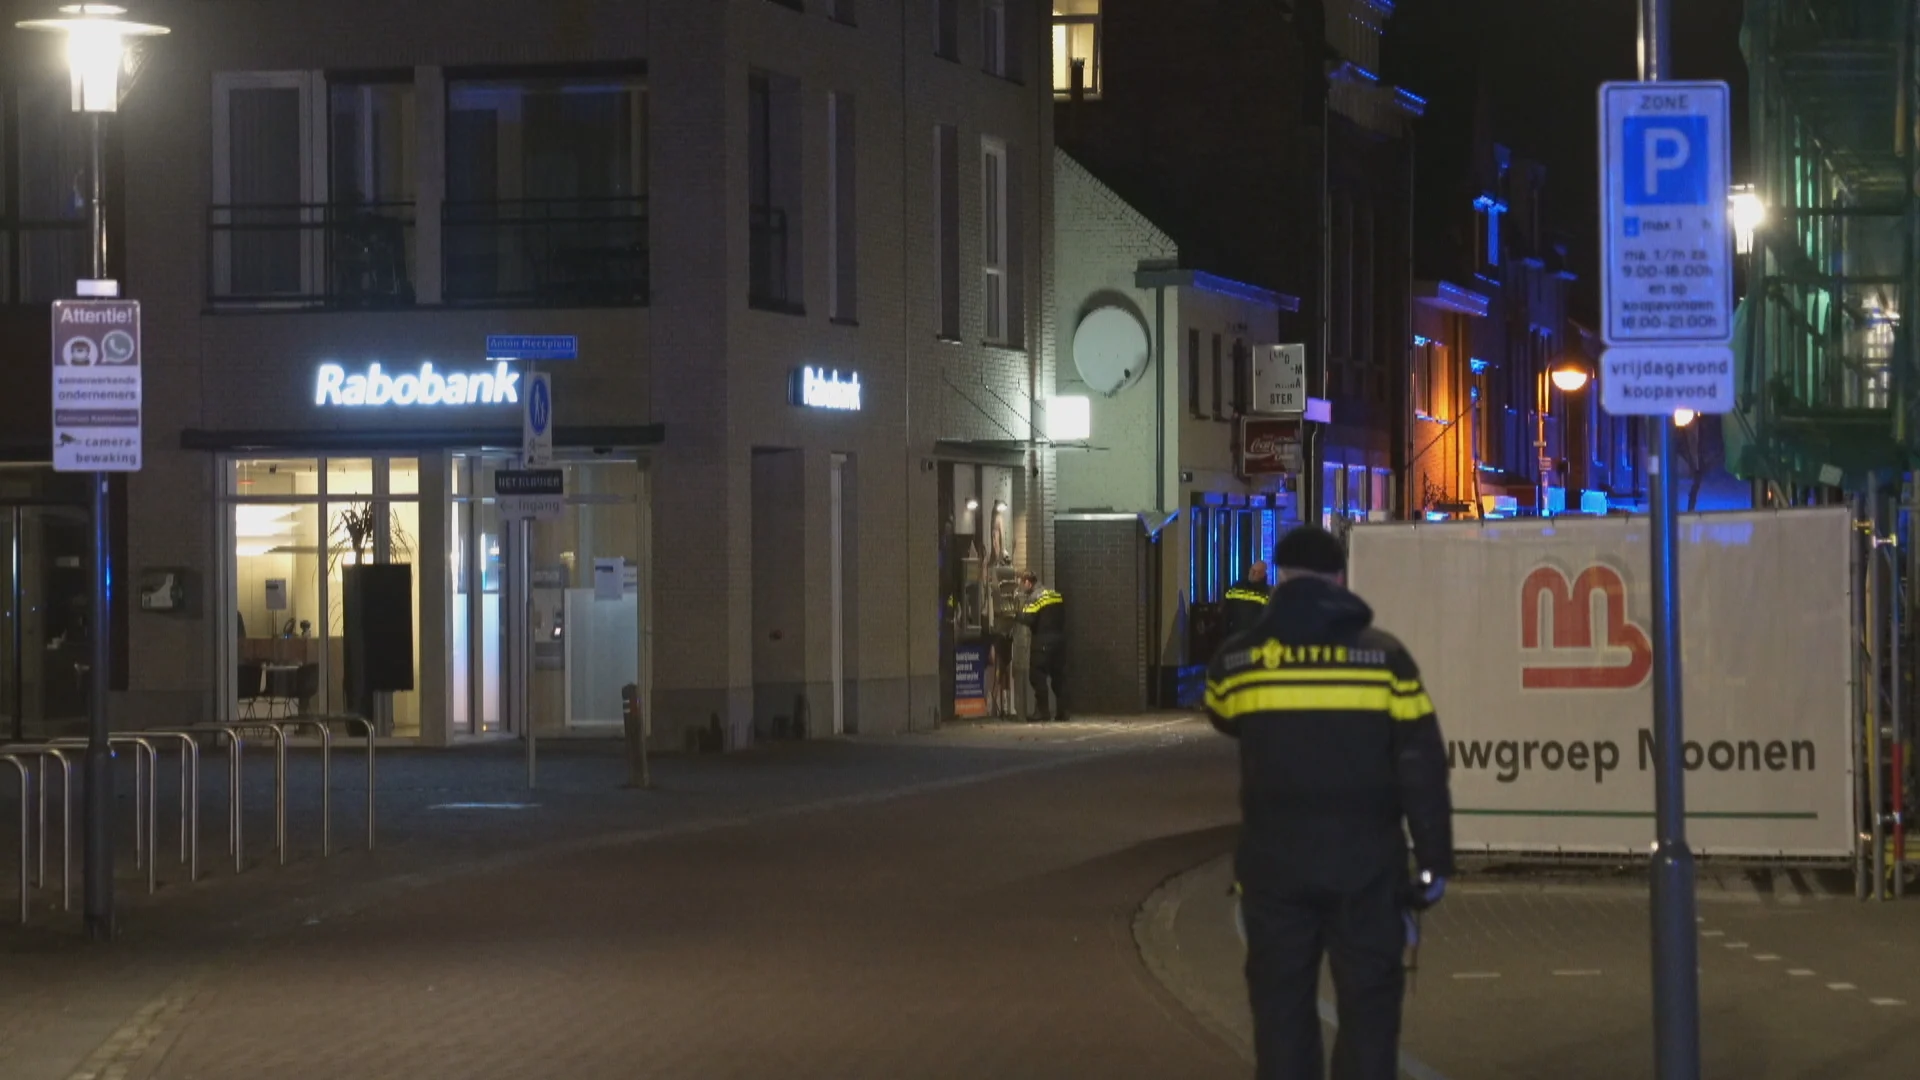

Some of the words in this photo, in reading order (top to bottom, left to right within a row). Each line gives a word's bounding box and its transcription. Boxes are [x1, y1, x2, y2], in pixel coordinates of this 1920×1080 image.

[1640, 95, 1689, 110] ZONE
[1645, 128, 1690, 196] P
[61, 307, 132, 324] Attentie!
[1611, 360, 1728, 380] vrijdagavond
[315, 361, 520, 406] Rabobank
[58, 389, 136, 401] ondernemers
[1623, 383, 1718, 402] koopavond
[85, 437, 136, 447] camera-
[75, 453, 136, 466] bewaking
